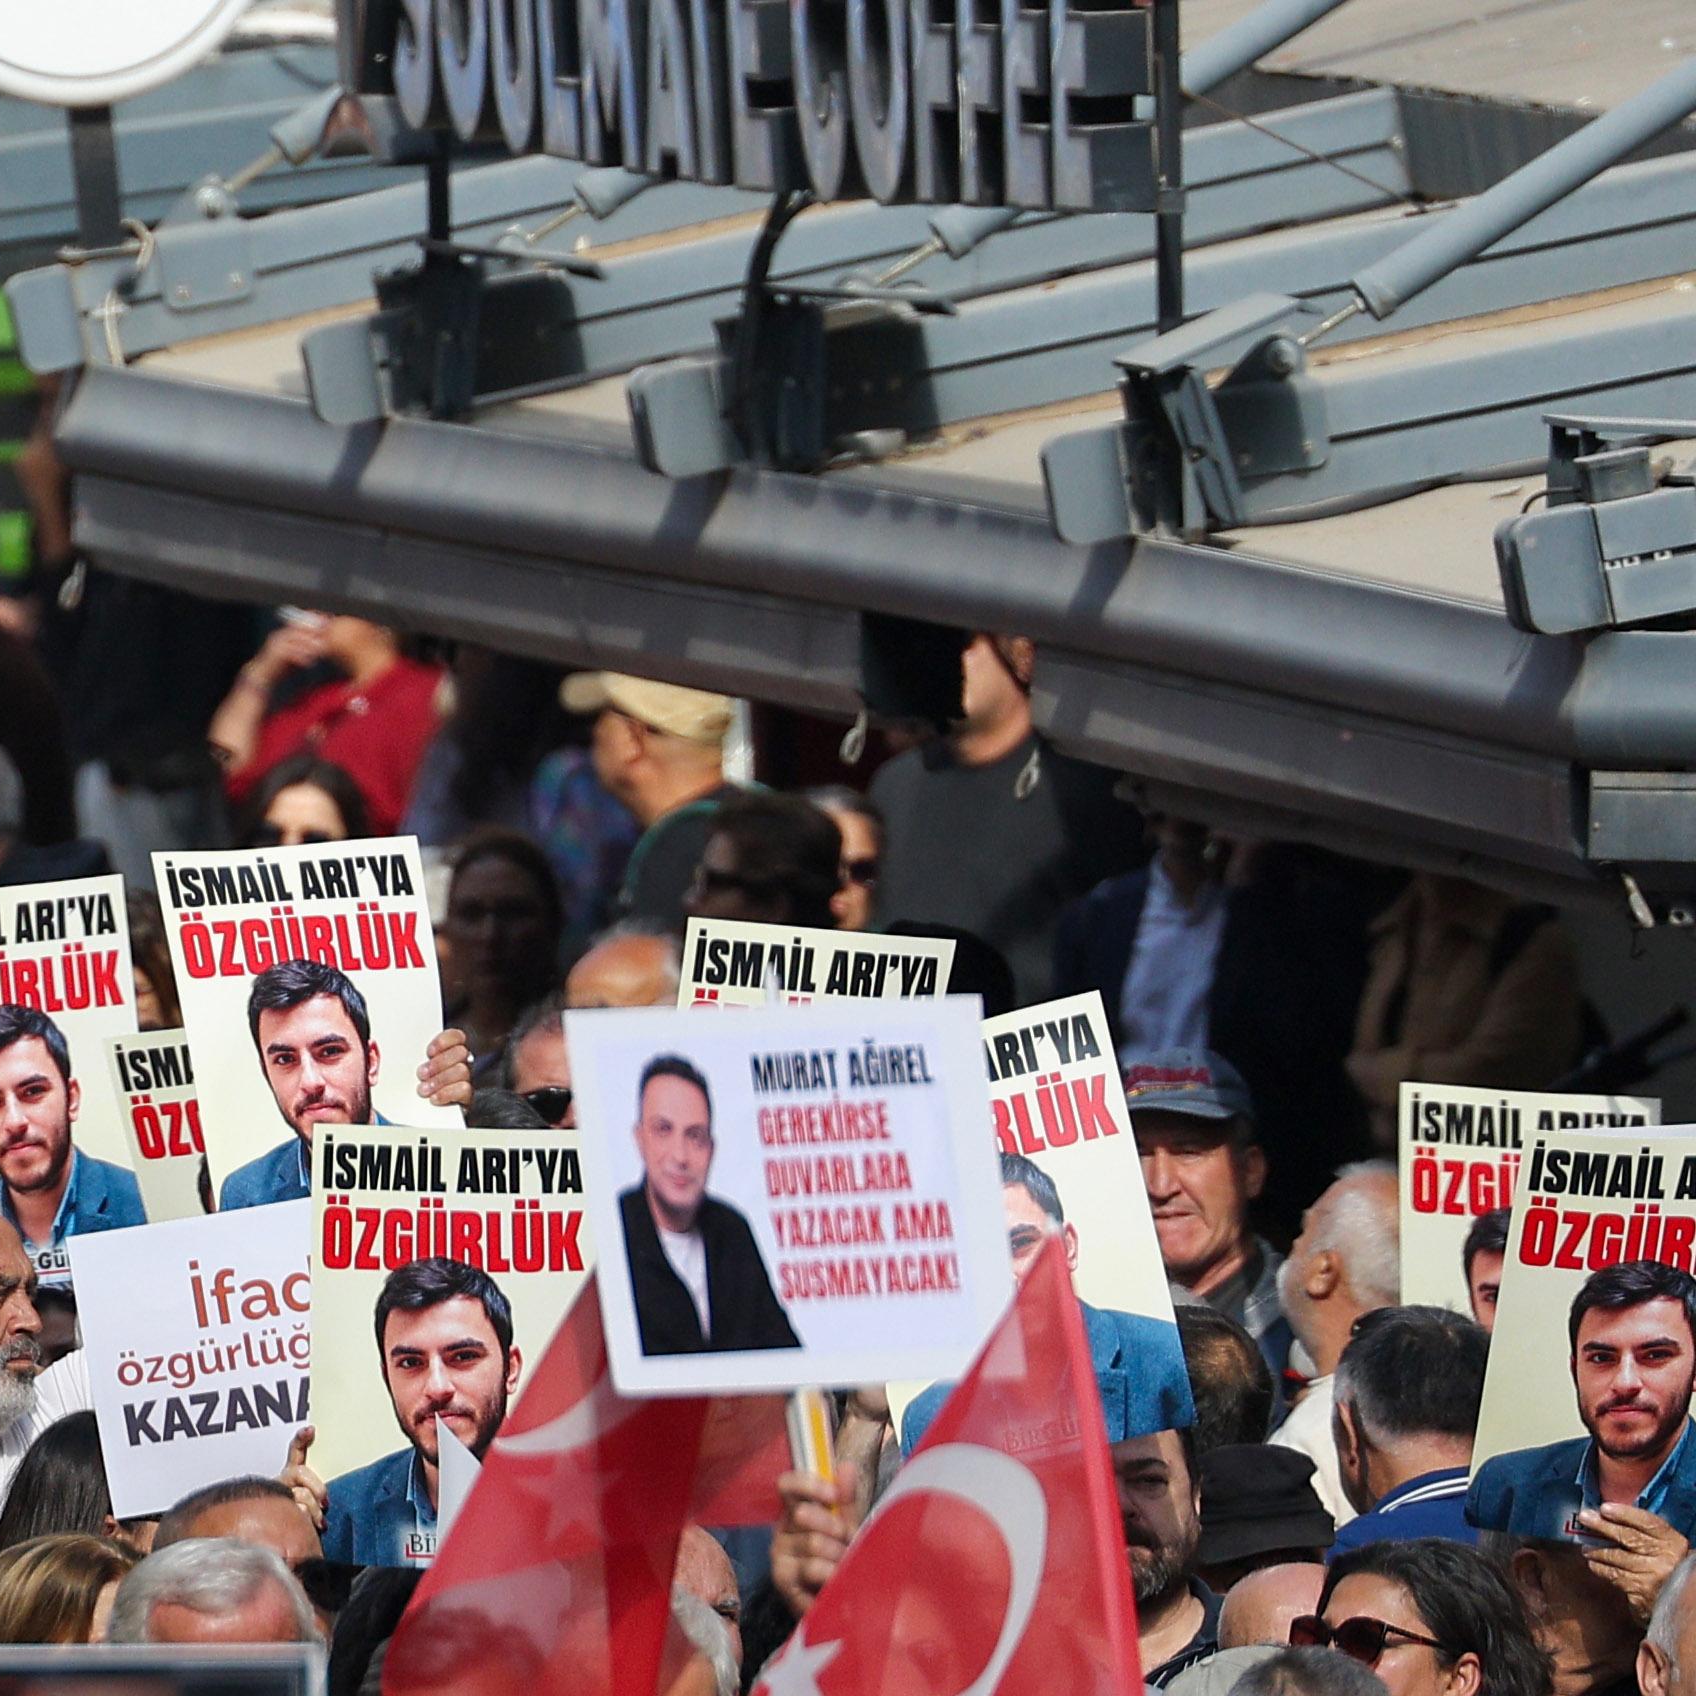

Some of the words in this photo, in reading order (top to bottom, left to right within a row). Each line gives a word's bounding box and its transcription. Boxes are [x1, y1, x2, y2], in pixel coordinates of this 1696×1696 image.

[164, 857, 294, 908] İSMAİL
[179, 901, 426, 979] ÖZGÜRLÜK
[692, 928, 816, 993] İSMAİL
[749, 1049, 839, 1095] MURAT
[848, 1038, 935, 1086] AĞIREL
[757, 1092, 892, 1148] GEREKİRSE
[1412, 1092, 1523, 1150] İSMAİL
[322, 1134, 447, 1192] İSMAİL
[763, 1150, 913, 1199] DUVARLARA
[1528, 1139, 1665, 1200] İSMAİL
[322, 1193, 585, 1273] ÖZGÜRLÜK
[771, 1204, 885, 1249] YAZACAK
[892, 1199, 955, 1241] AMA
[1519, 1195, 1696, 1276] ÖZGÜR
[778, 1251, 961, 1301] SUSMAYACAK!
